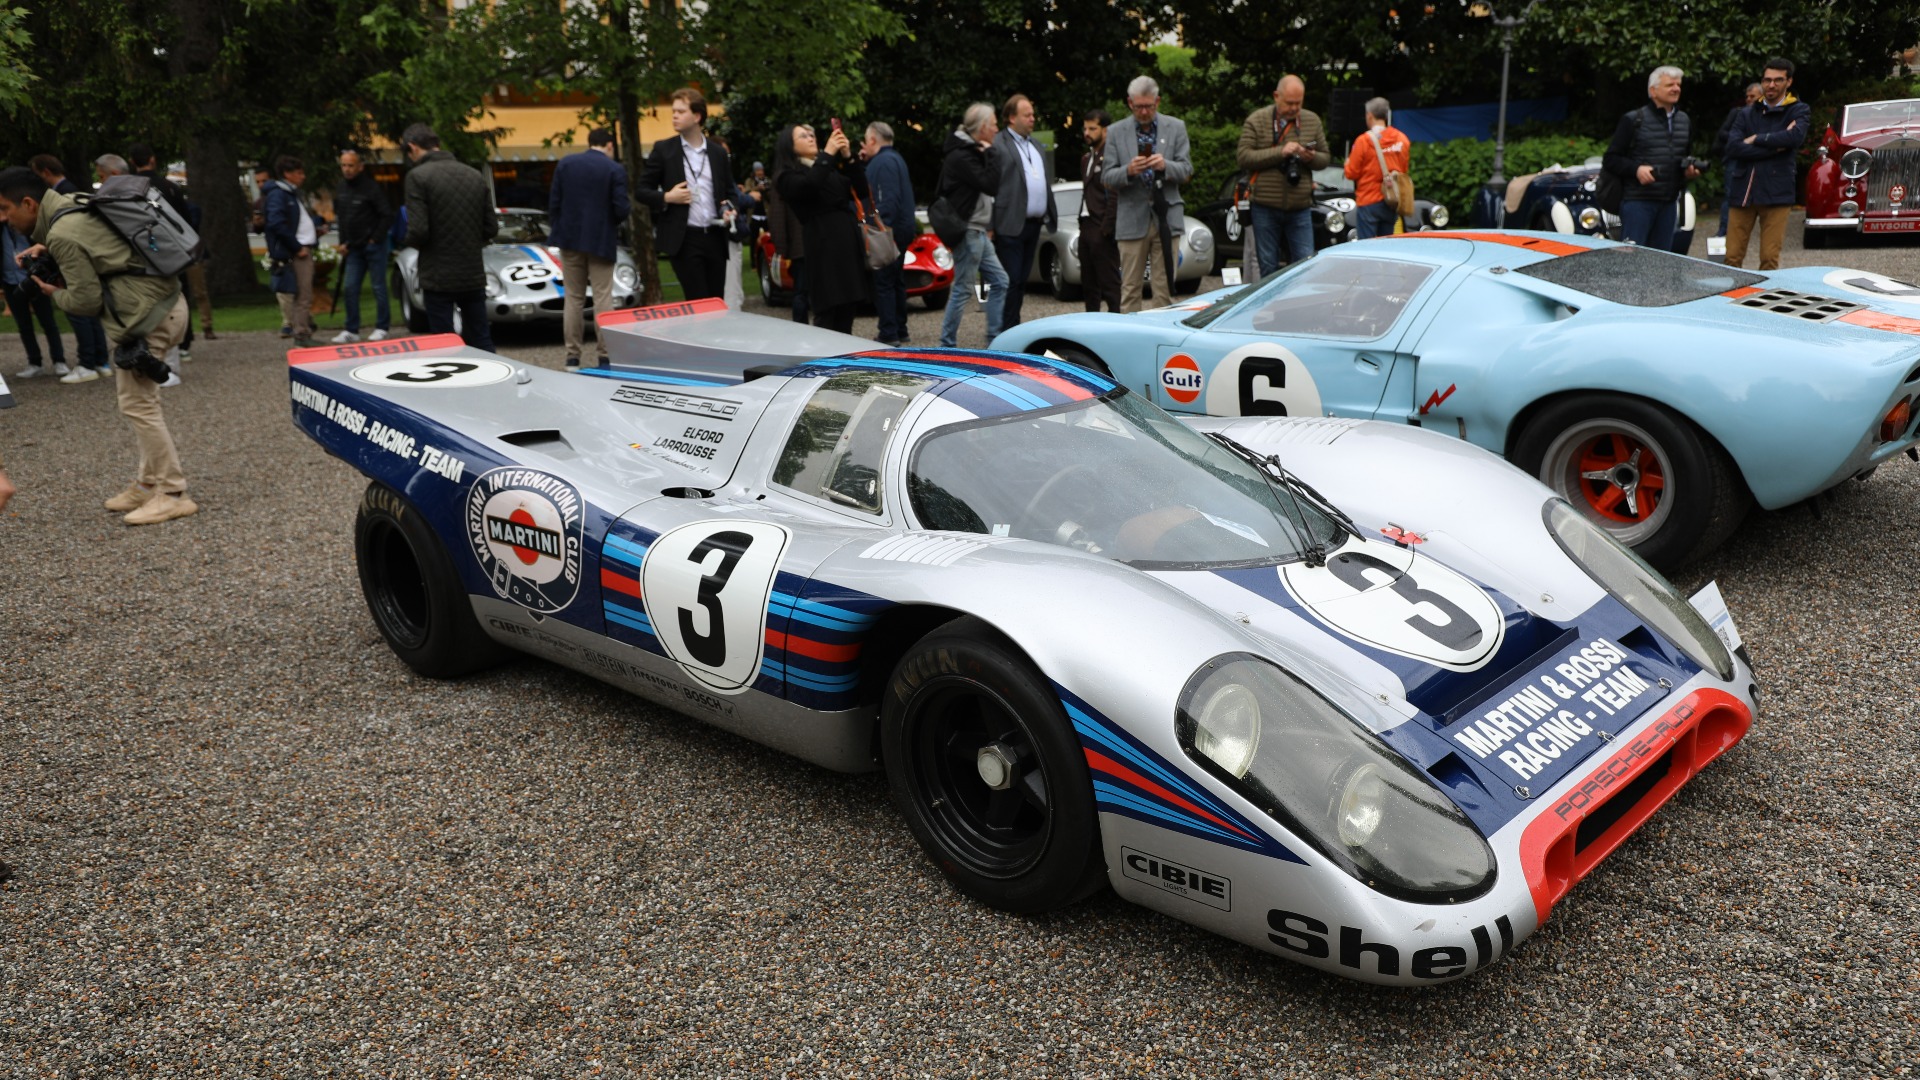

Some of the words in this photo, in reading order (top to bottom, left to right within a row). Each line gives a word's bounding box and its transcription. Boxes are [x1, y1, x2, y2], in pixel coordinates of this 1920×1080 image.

[1870, 222, 1915, 230] MYSORE
[507, 264, 551, 281] 25
[632, 303, 695, 321] Shell
[335, 340, 420, 359] Shell
[385, 362, 480, 382] 3
[1162, 370, 1201, 388] Gulf
[1238, 356, 1288, 417] 6
[291, 381, 329, 416] MARTINI
[327, 399, 337, 420] &
[336, 402, 366, 435] ROSSI
[367, 421, 416, 459] RACING
[419, 445, 466, 484] TEAM
[683, 427, 724, 444] ELFORD
[653, 437, 717, 460] LARROUSSE
[470, 486, 491, 563] MARTINI
[488, 470, 579, 530] INTERNATIONAL
[565, 536, 578, 585] CLUB
[489, 519, 559, 556] MARTINI
[678, 530, 753, 668] 3
[1327, 551, 1483, 651] 3
[488, 619, 534, 638] CIBIE
[583, 648, 627, 676] BILSTEIN
[1555, 637, 1627, 689] ROSSI
[630, 666, 680, 692] Firestone
[1541, 675, 1576, 699] &
[684, 687, 723, 711] BOSCH
[1454, 684, 1558, 759] MARTINI
[1498, 709, 1593, 781] RACING
[1581, 665, 1650, 717] TEAM
[1127, 854, 1225, 899] CIBIE
[1163, 882, 1188, 894] LIGHTS
[1266, 908, 1514, 980] Shell
